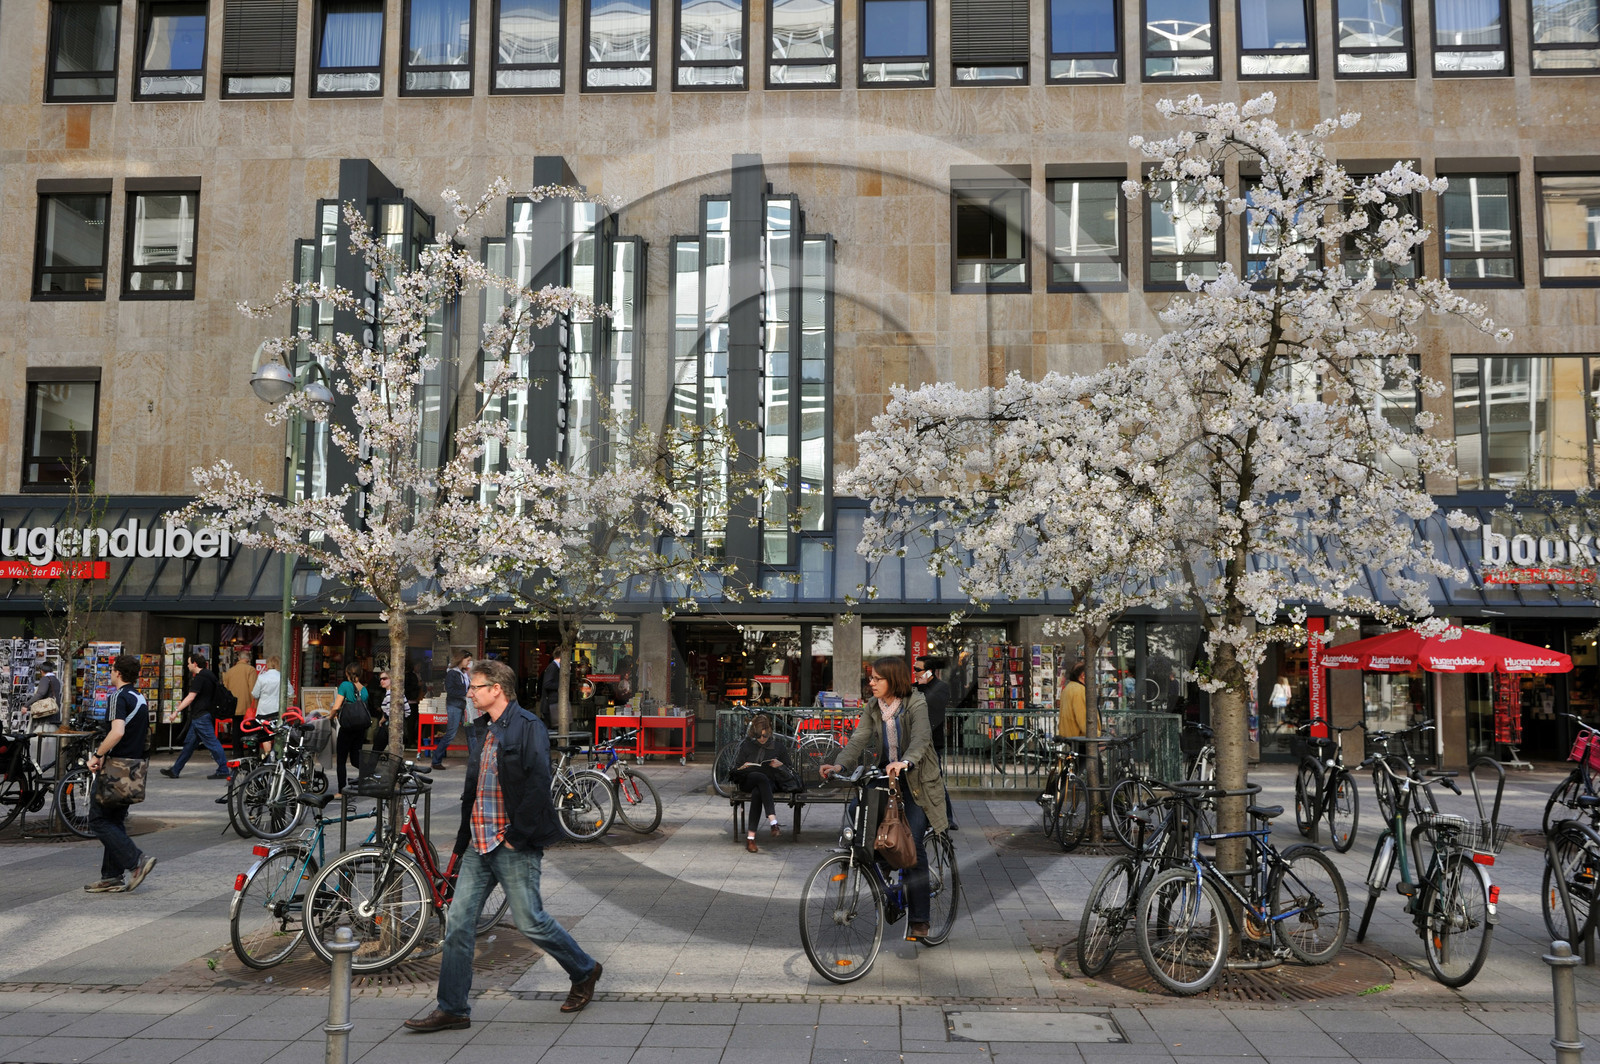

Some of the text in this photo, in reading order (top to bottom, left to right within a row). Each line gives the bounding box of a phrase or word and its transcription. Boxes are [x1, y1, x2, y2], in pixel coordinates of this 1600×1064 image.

[557, 288, 569, 453] ücher
[33, 566, 47, 576] der
[1430, 656, 1485, 666] Hugendubel.de
[1504, 657, 1560, 667] Hugendubel.de
